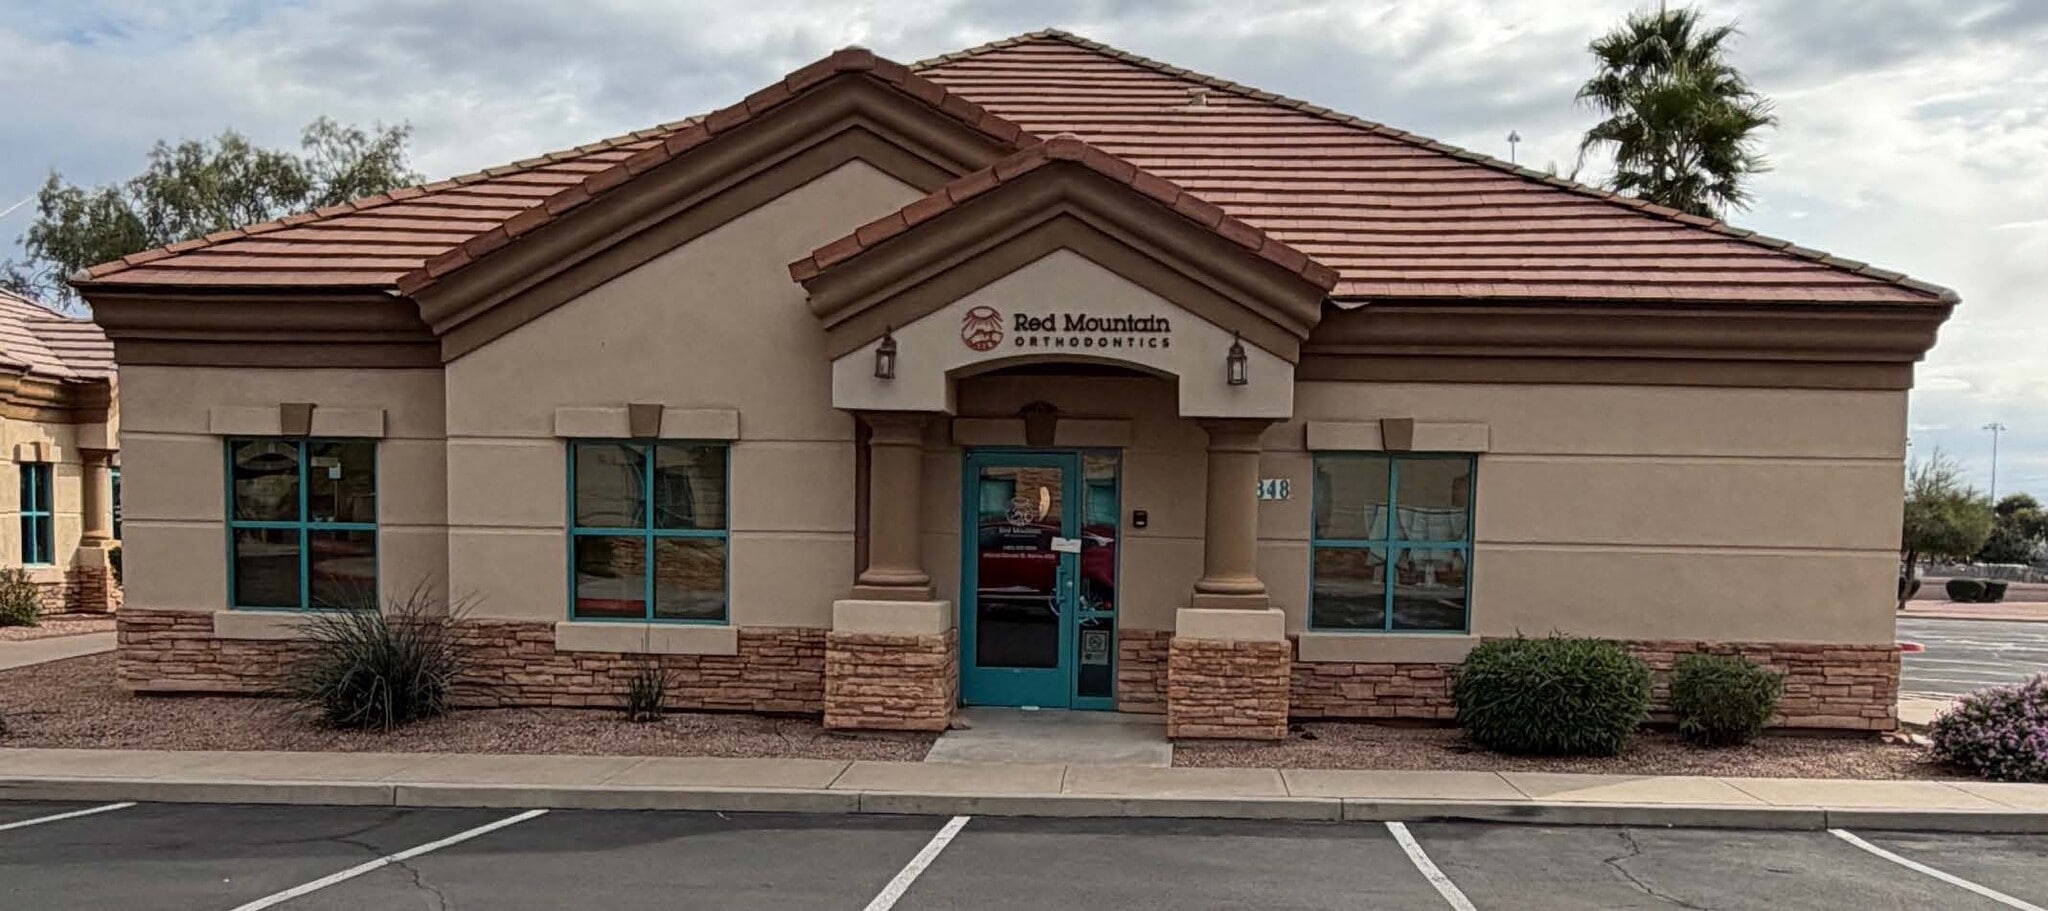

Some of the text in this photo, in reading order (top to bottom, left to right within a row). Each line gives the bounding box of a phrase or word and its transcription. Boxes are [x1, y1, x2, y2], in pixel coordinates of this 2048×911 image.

[1013, 313, 1171, 333] Red Mountain
[1014, 336, 1170, 348] ORTHODONTICS
